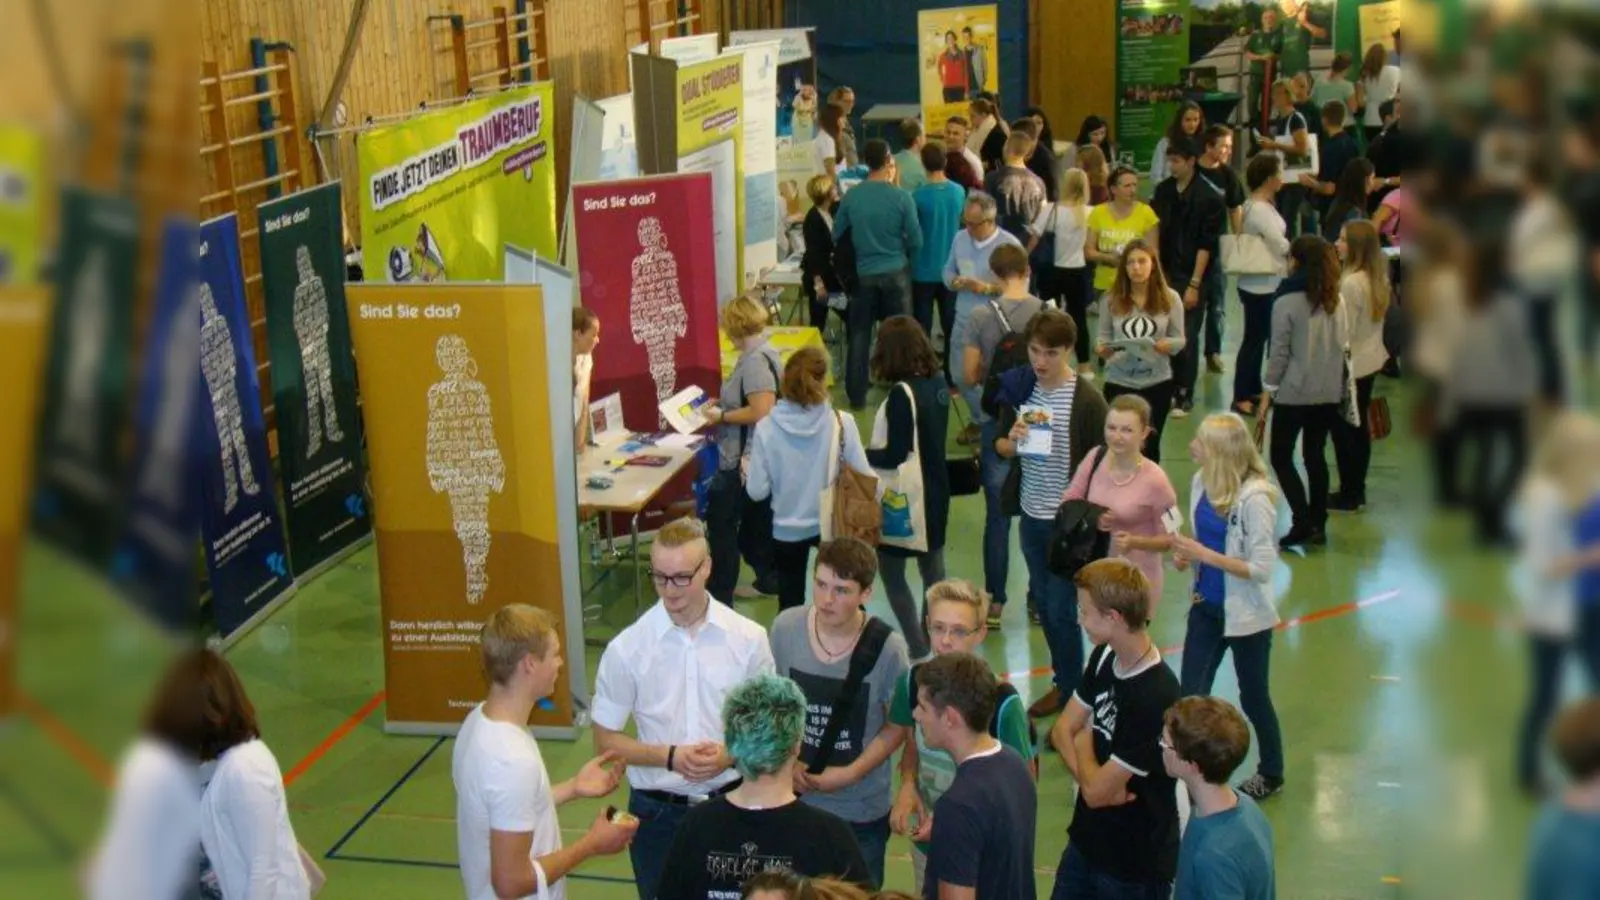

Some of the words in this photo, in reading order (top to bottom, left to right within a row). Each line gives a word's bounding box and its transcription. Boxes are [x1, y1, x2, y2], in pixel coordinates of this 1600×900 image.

[373, 171, 399, 204] FINDE
[401, 157, 427, 192] JETZT
[428, 144, 459, 179] DEINEN
[459, 99, 540, 165] TRAUMBERUF
[583, 196, 608, 211] Sind
[610, 194, 627, 209] Sie
[629, 191, 656, 207] das?
[265, 217, 281, 233] Sind
[281, 213, 292, 228] Sie
[293, 206, 310, 223] das?
[360, 303, 392, 319] Sind
[397, 302, 419, 319] Sie
[424, 303, 461, 319] das?
[390, 620, 415, 630] Dann
[417, 619, 454, 630] herzlich
[391, 634, 402, 642] zu
[404, 633, 427, 643] einer
